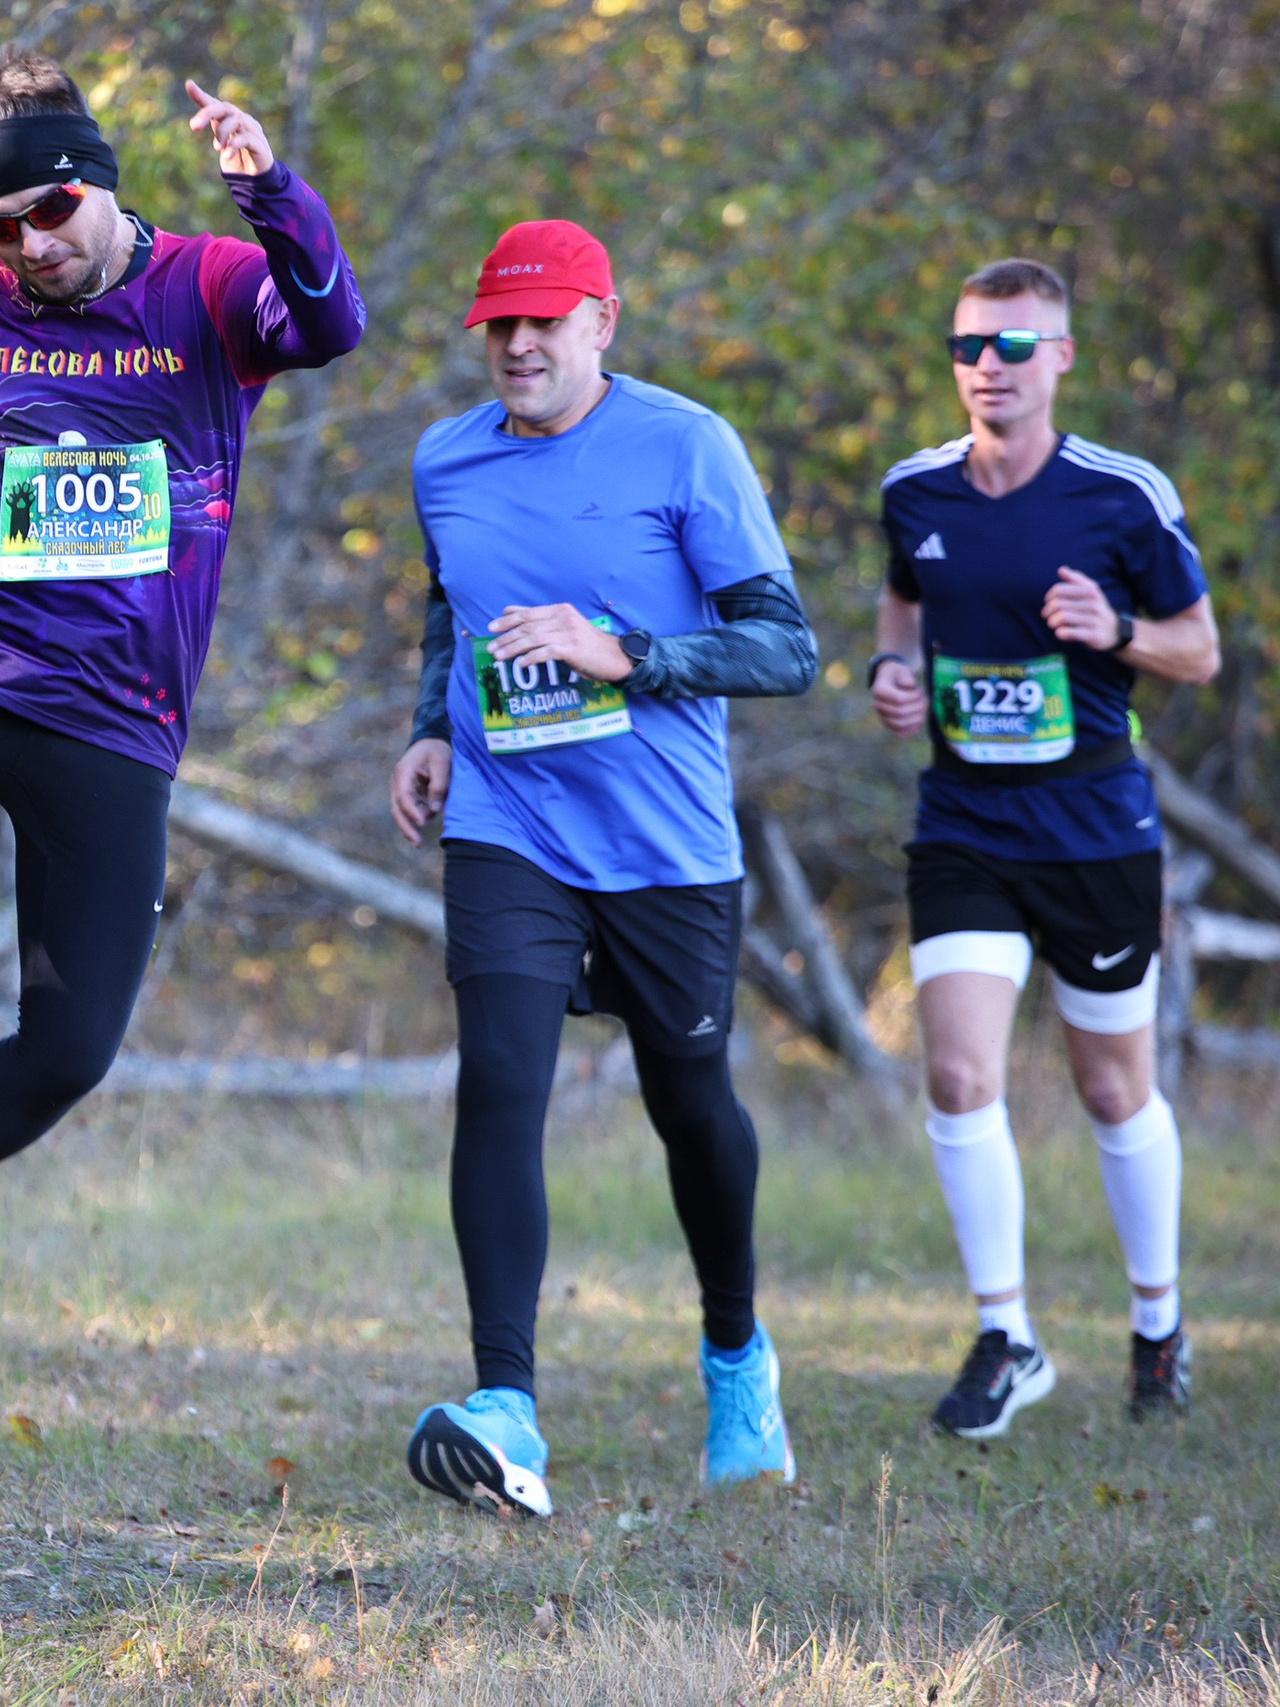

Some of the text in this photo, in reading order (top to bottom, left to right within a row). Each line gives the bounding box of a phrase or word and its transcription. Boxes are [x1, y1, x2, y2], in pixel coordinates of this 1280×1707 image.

[497, 264, 544, 276] MOAX
[115, 345, 186, 378] НОЧЬ
[43, 451, 127, 467] ВЕЛЕСОВА НОЧЬ
[31, 472, 143, 514] 1005
[143, 492, 162, 521] 10
[27, 519, 144, 540] АЛЕКСАНДР
[45, 539, 126, 555] СКАЗОЧНЫЙ ЛЕС
[508, 690, 580, 714] ВАДИМ
[953, 679, 1045, 714] 1229
